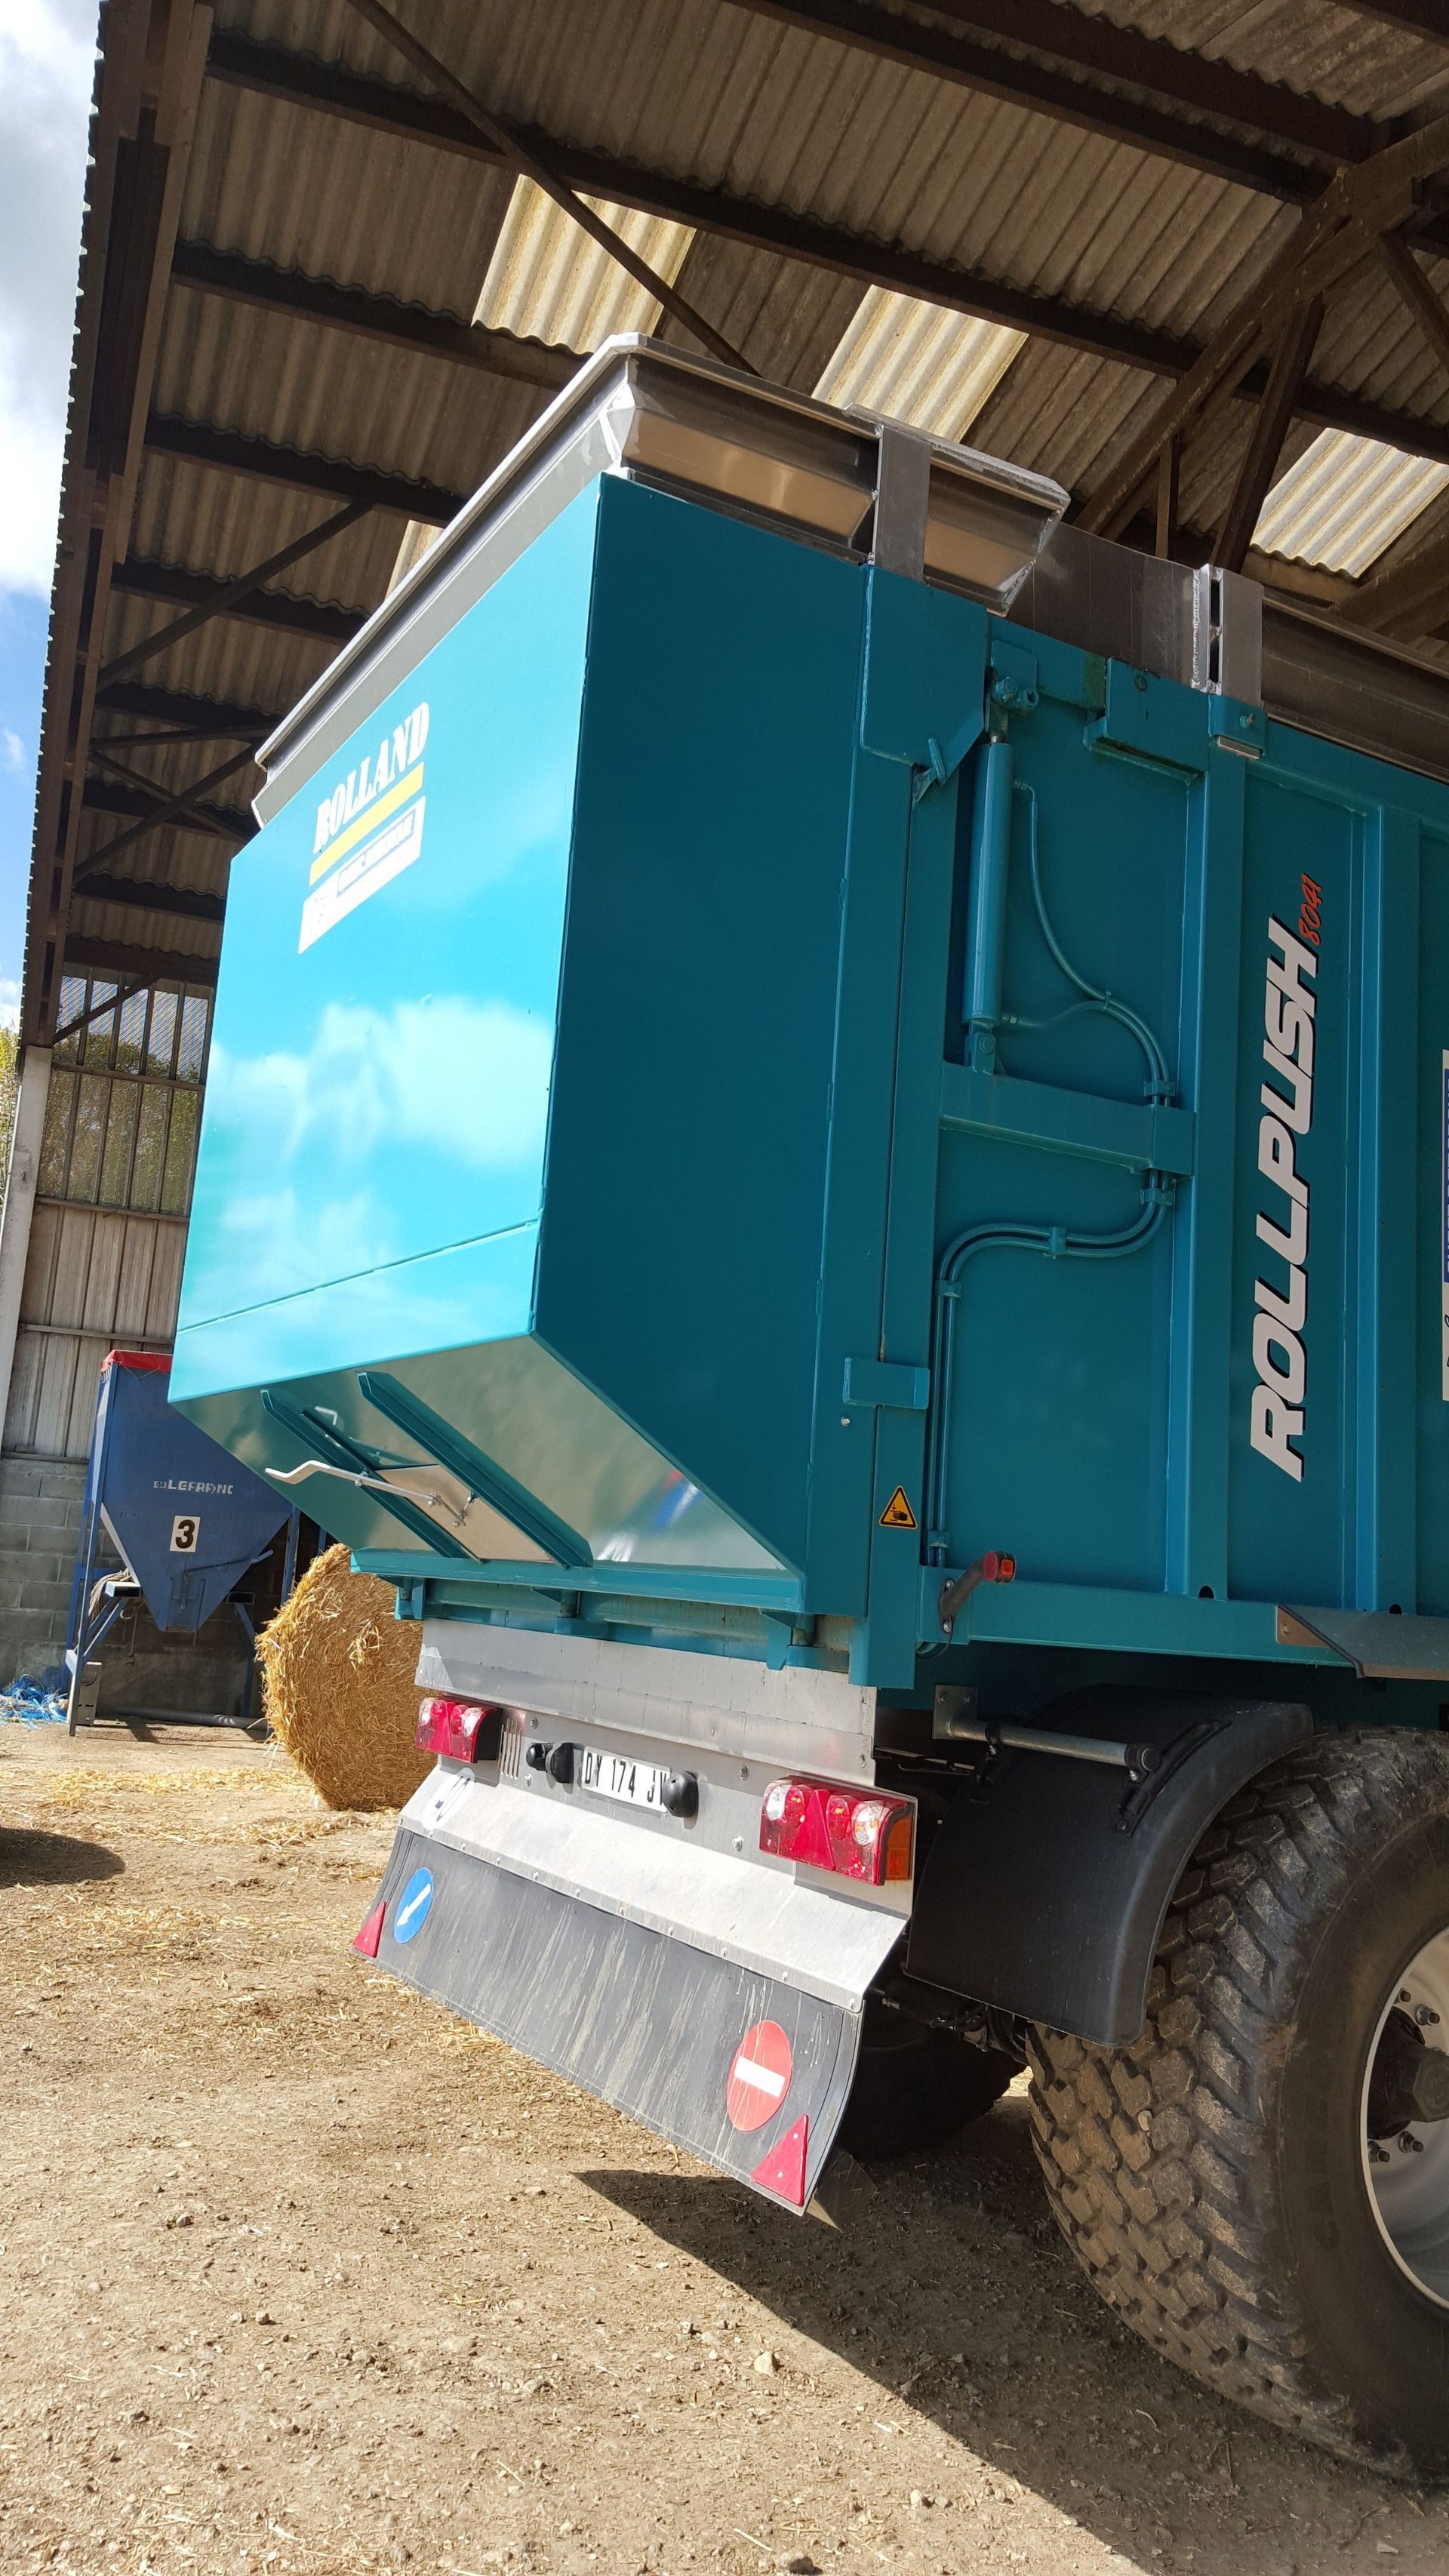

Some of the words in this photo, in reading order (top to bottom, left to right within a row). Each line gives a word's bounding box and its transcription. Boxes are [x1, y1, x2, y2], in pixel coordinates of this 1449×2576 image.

[312, 702, 429, 854] ROLLAND
[1298, 873, 1323, 946] 8041
[1249, 914, 1320, 1484] ROLLPUSH
[175, 1519, 195, 1549] 3
[585, 1752, 602, 1787] DY
[611, 1759, 636, 1798] 174
